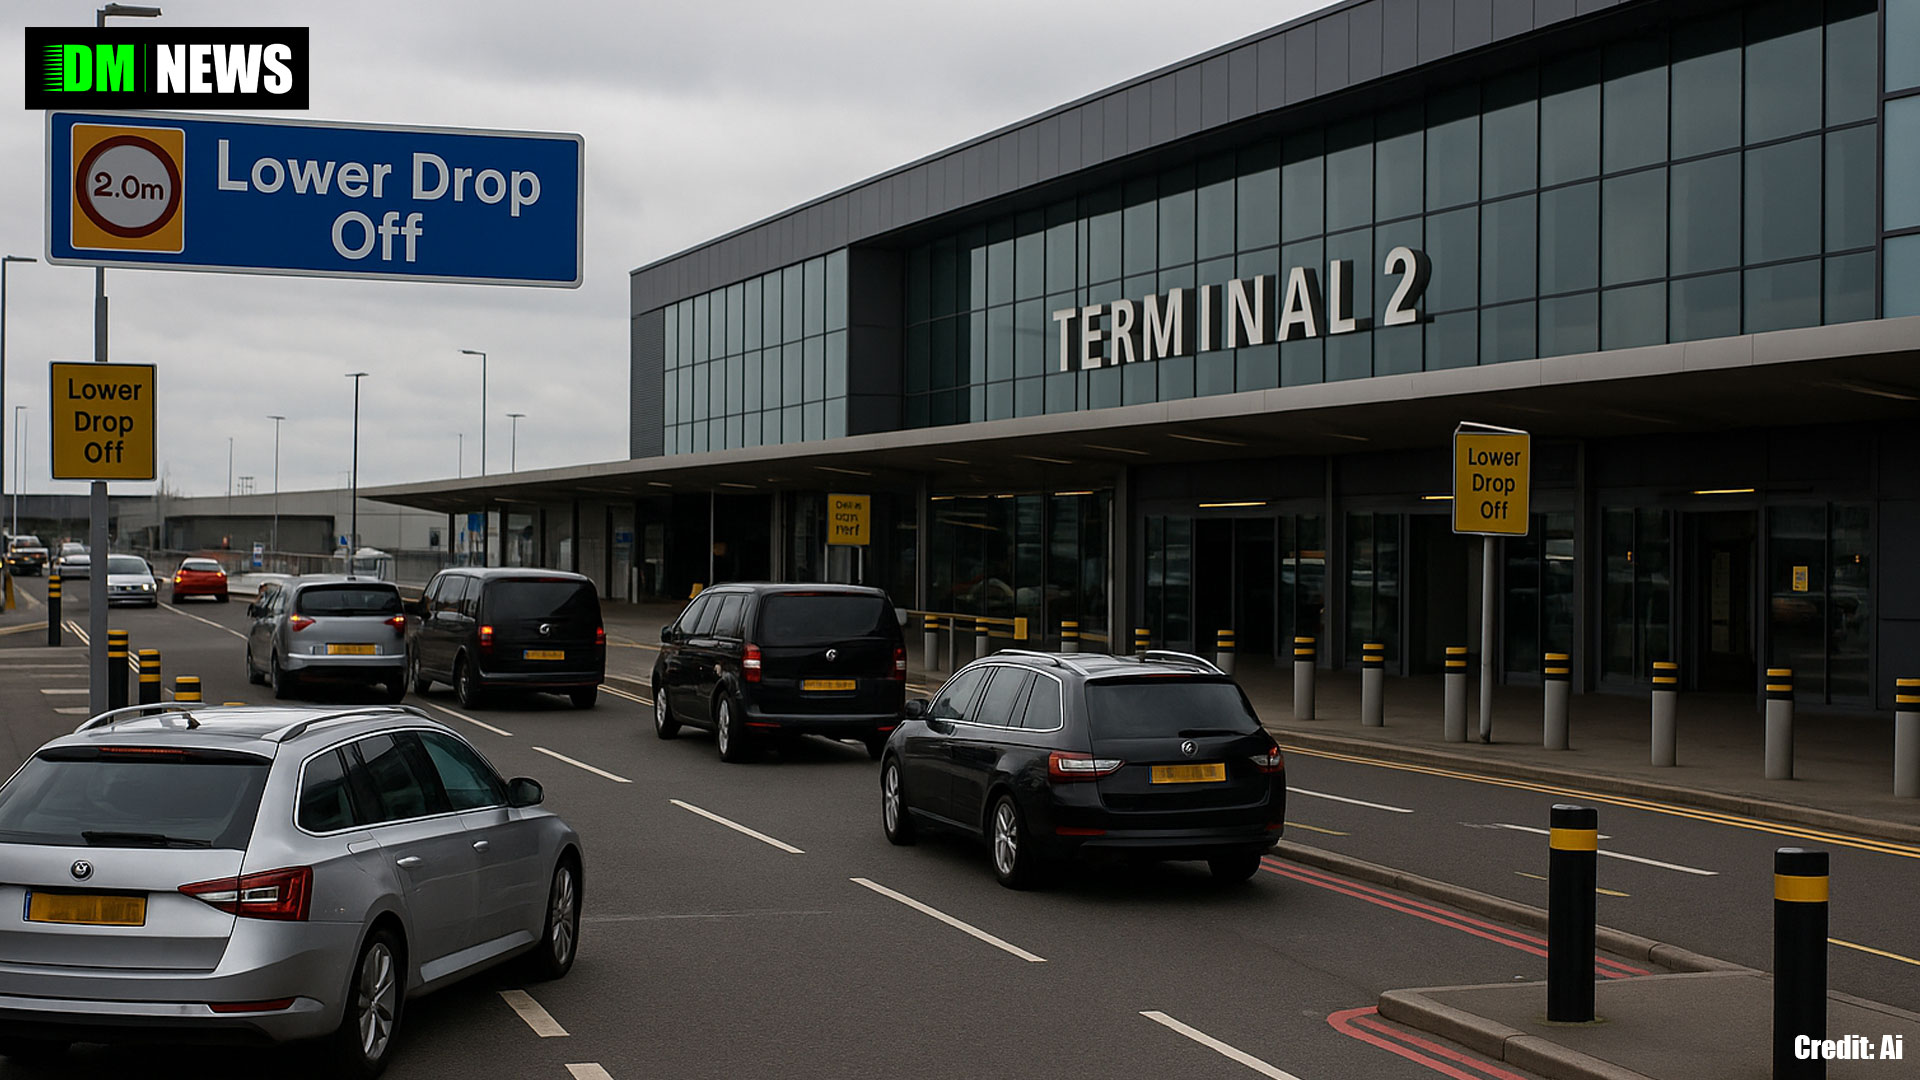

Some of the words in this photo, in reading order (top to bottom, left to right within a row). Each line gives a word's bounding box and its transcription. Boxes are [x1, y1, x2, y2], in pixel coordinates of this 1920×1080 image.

[93, 172, 165, 202] 2.0m
[217, 138, 392, 199] Lower
[411, 152, 541, 217] Drop
[331, 210, 424, 262] Off
[1052, 259, 1357, 372] TERMINAL
[1383, 246, 1420, 326] 2
[68, 378, 142, 401] Lower
[74, 411, 134, 437] Drop
[84, 440, 124, 464] Off
[1467, 447, 1521, 467] Lower
[1472, 473, 1516, 497] Drop
[1480, 500, 1508, 521] Off
